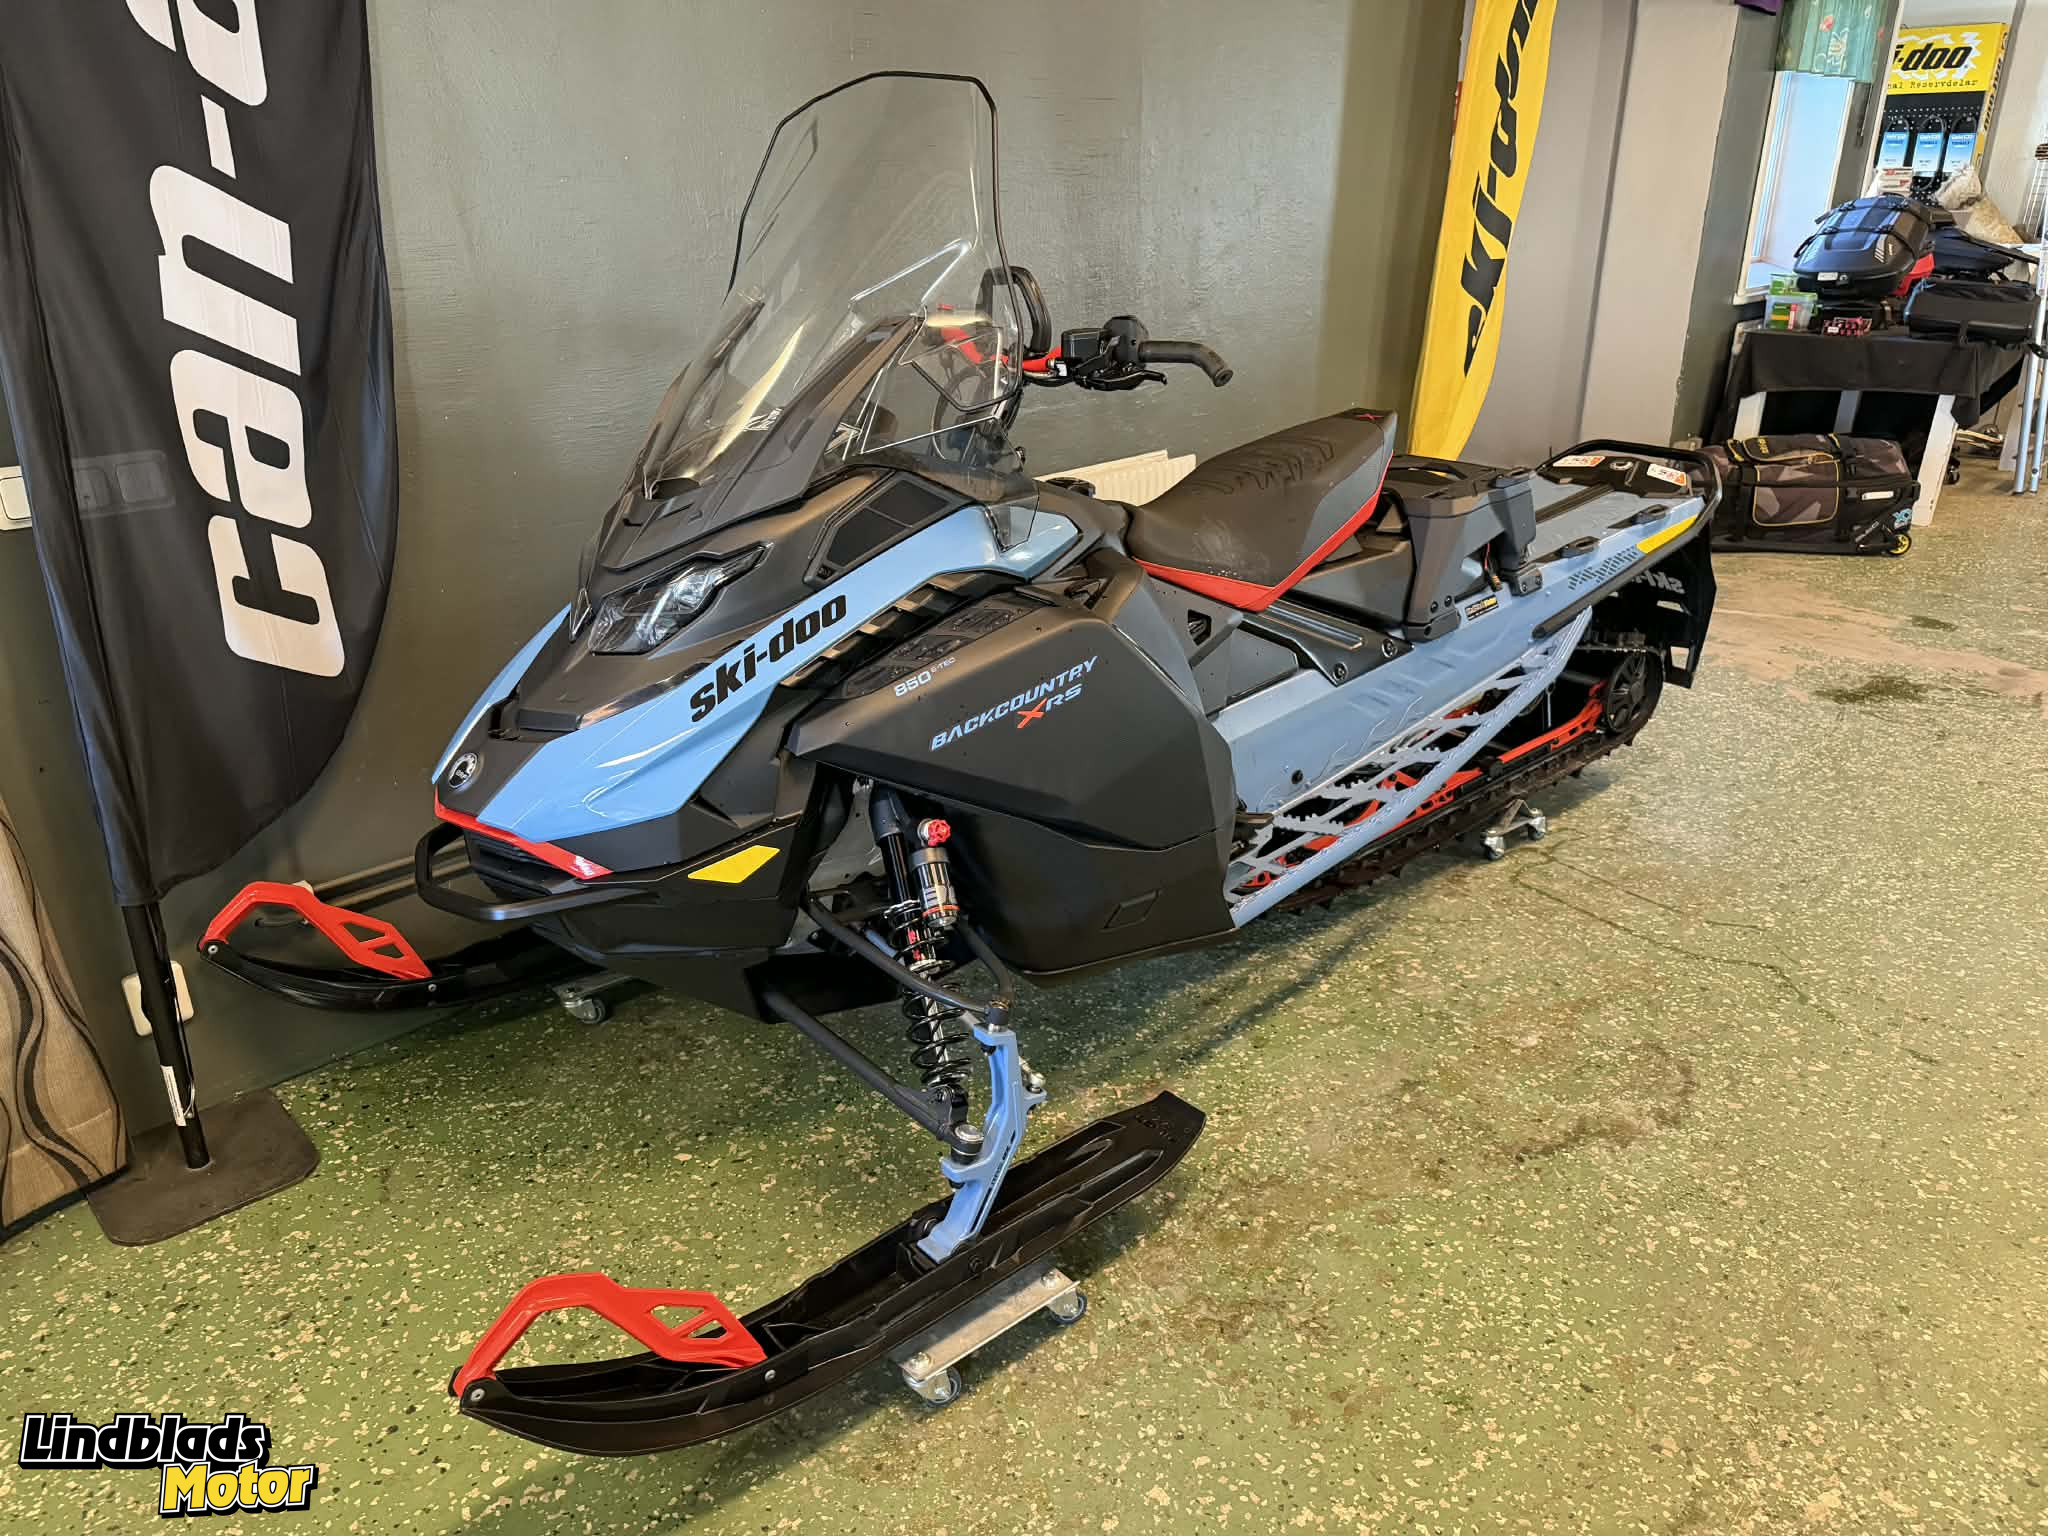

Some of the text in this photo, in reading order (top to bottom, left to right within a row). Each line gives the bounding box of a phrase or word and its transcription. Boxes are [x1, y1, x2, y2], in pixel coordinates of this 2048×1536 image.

[690, 595, 846, 722] ski-doo
[894, 670, 932, 697] 850
[931, 656, 1098, 750] BACKCOUNTRY
